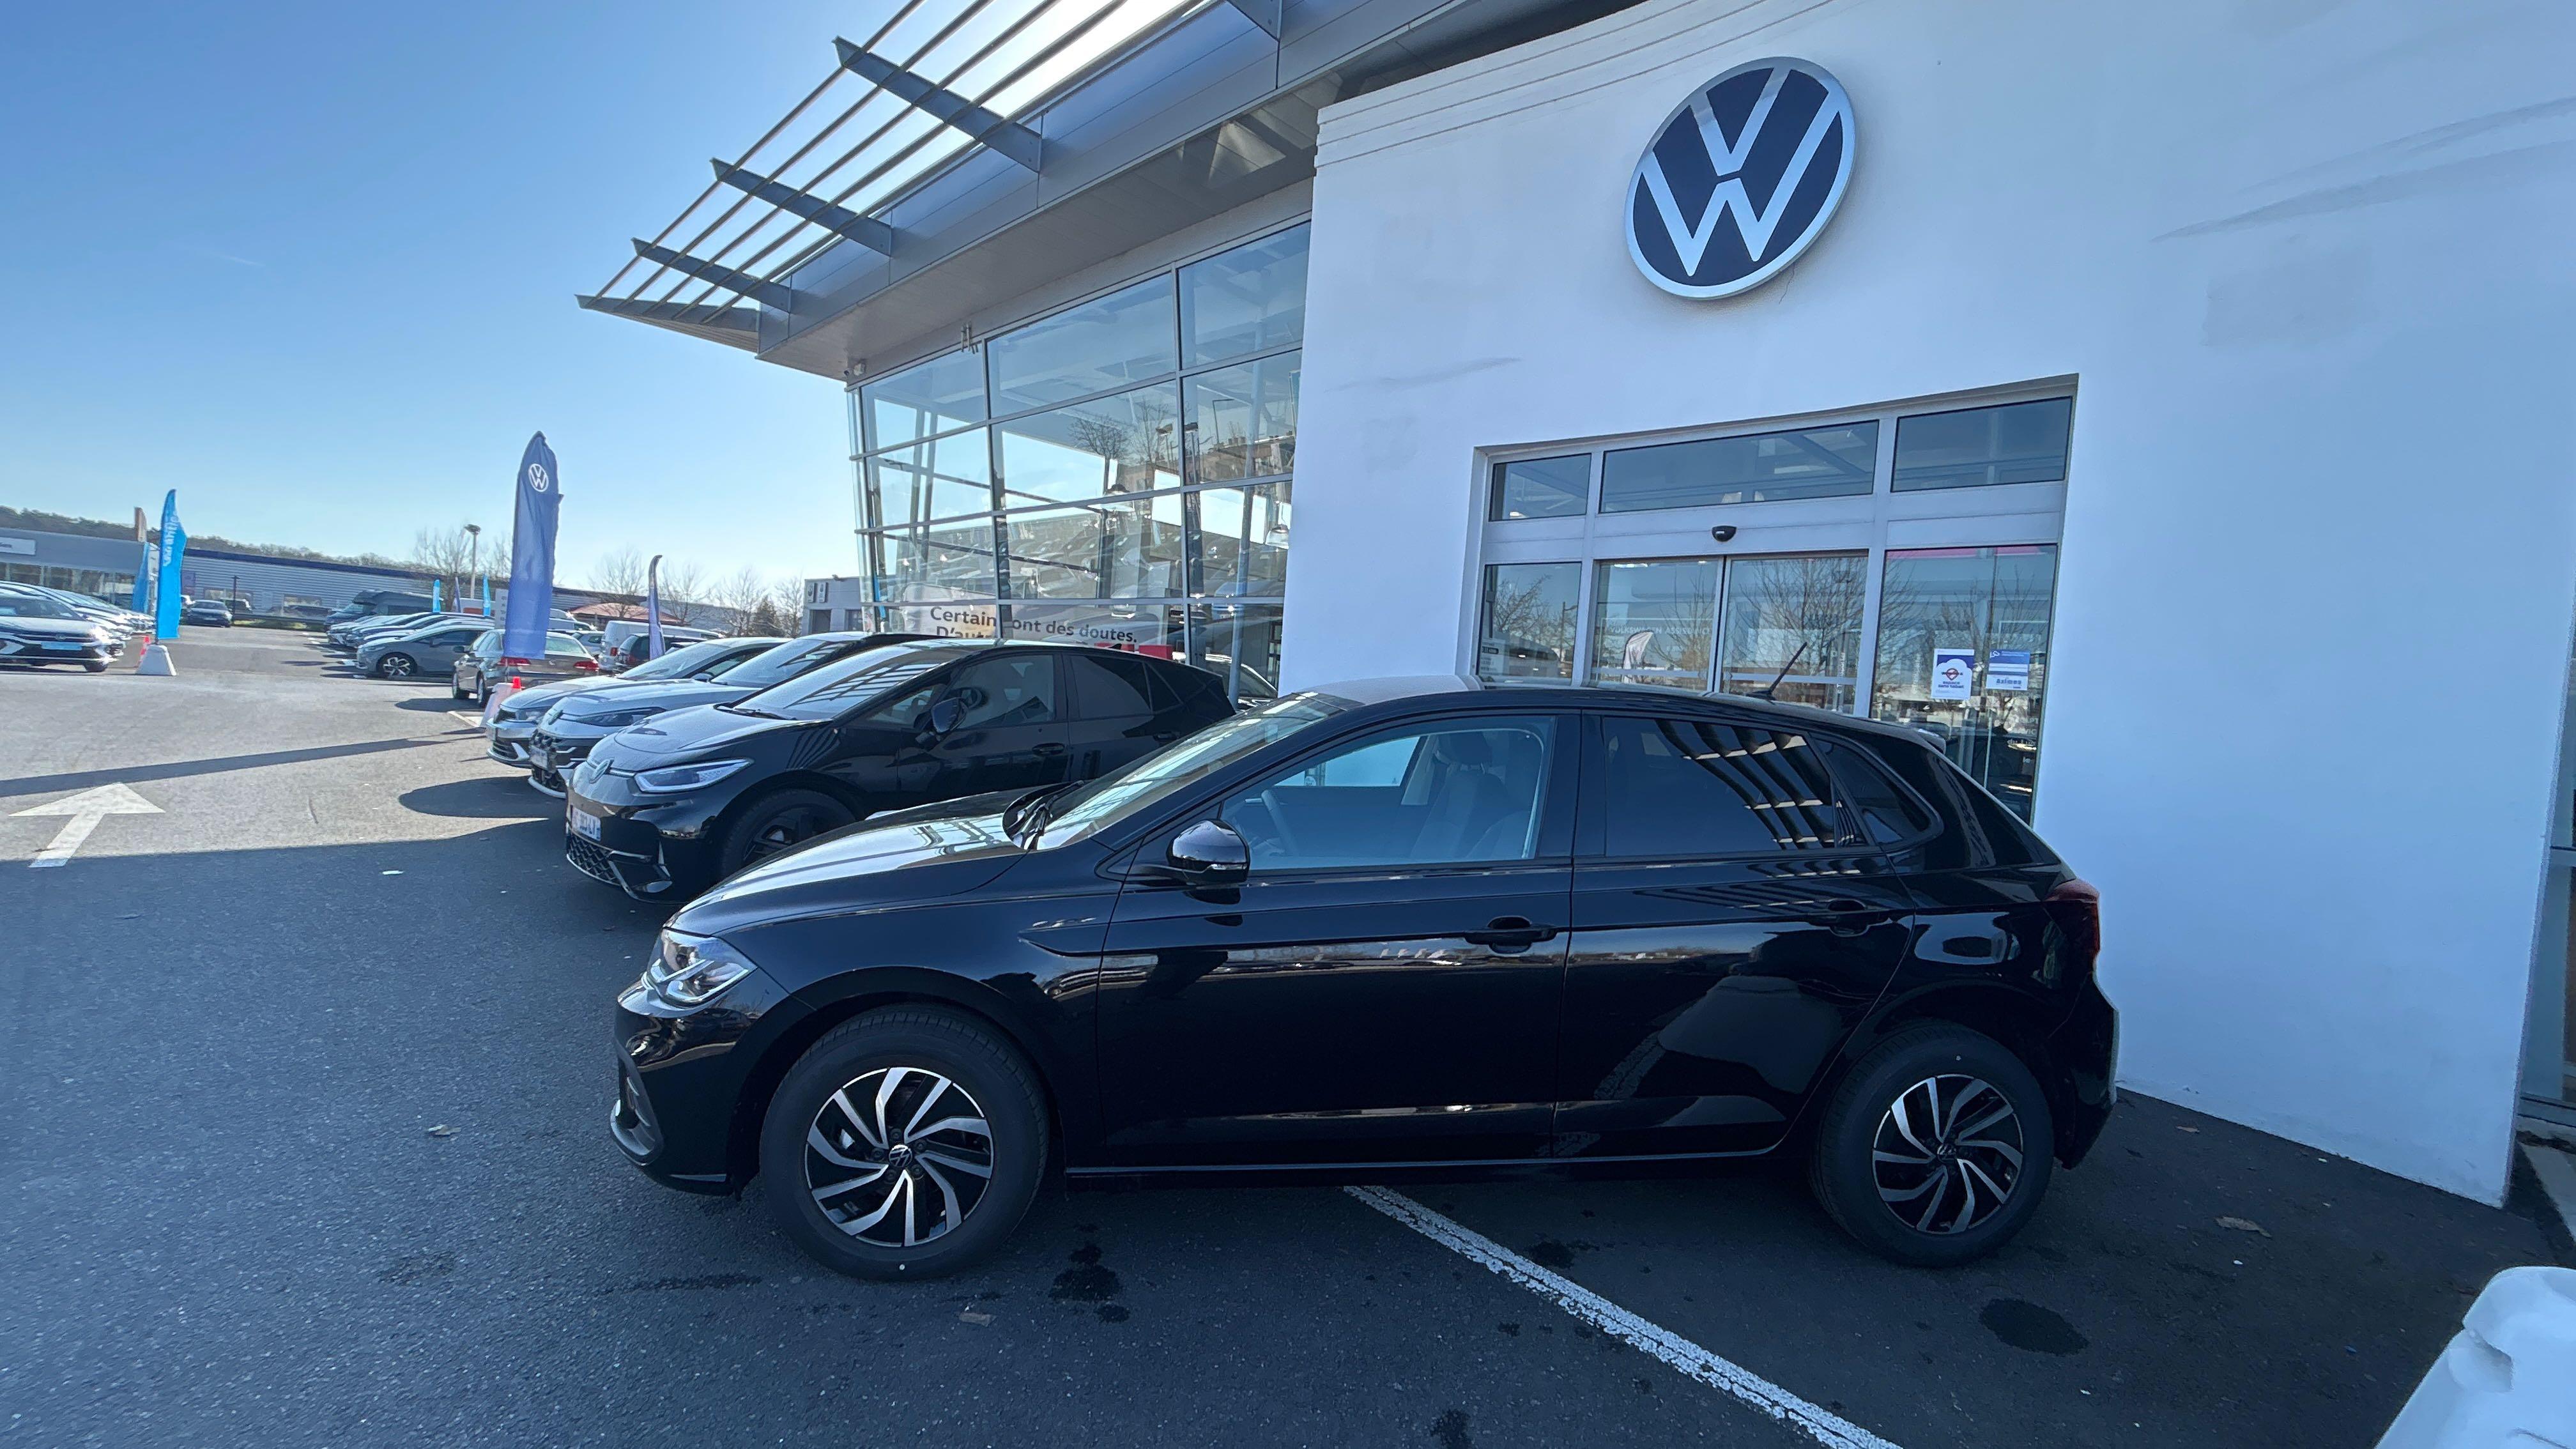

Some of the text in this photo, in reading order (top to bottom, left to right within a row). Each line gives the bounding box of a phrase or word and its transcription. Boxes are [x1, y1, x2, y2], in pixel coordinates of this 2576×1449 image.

[930, 606, 1137, 643] Certain ont des doutes.
